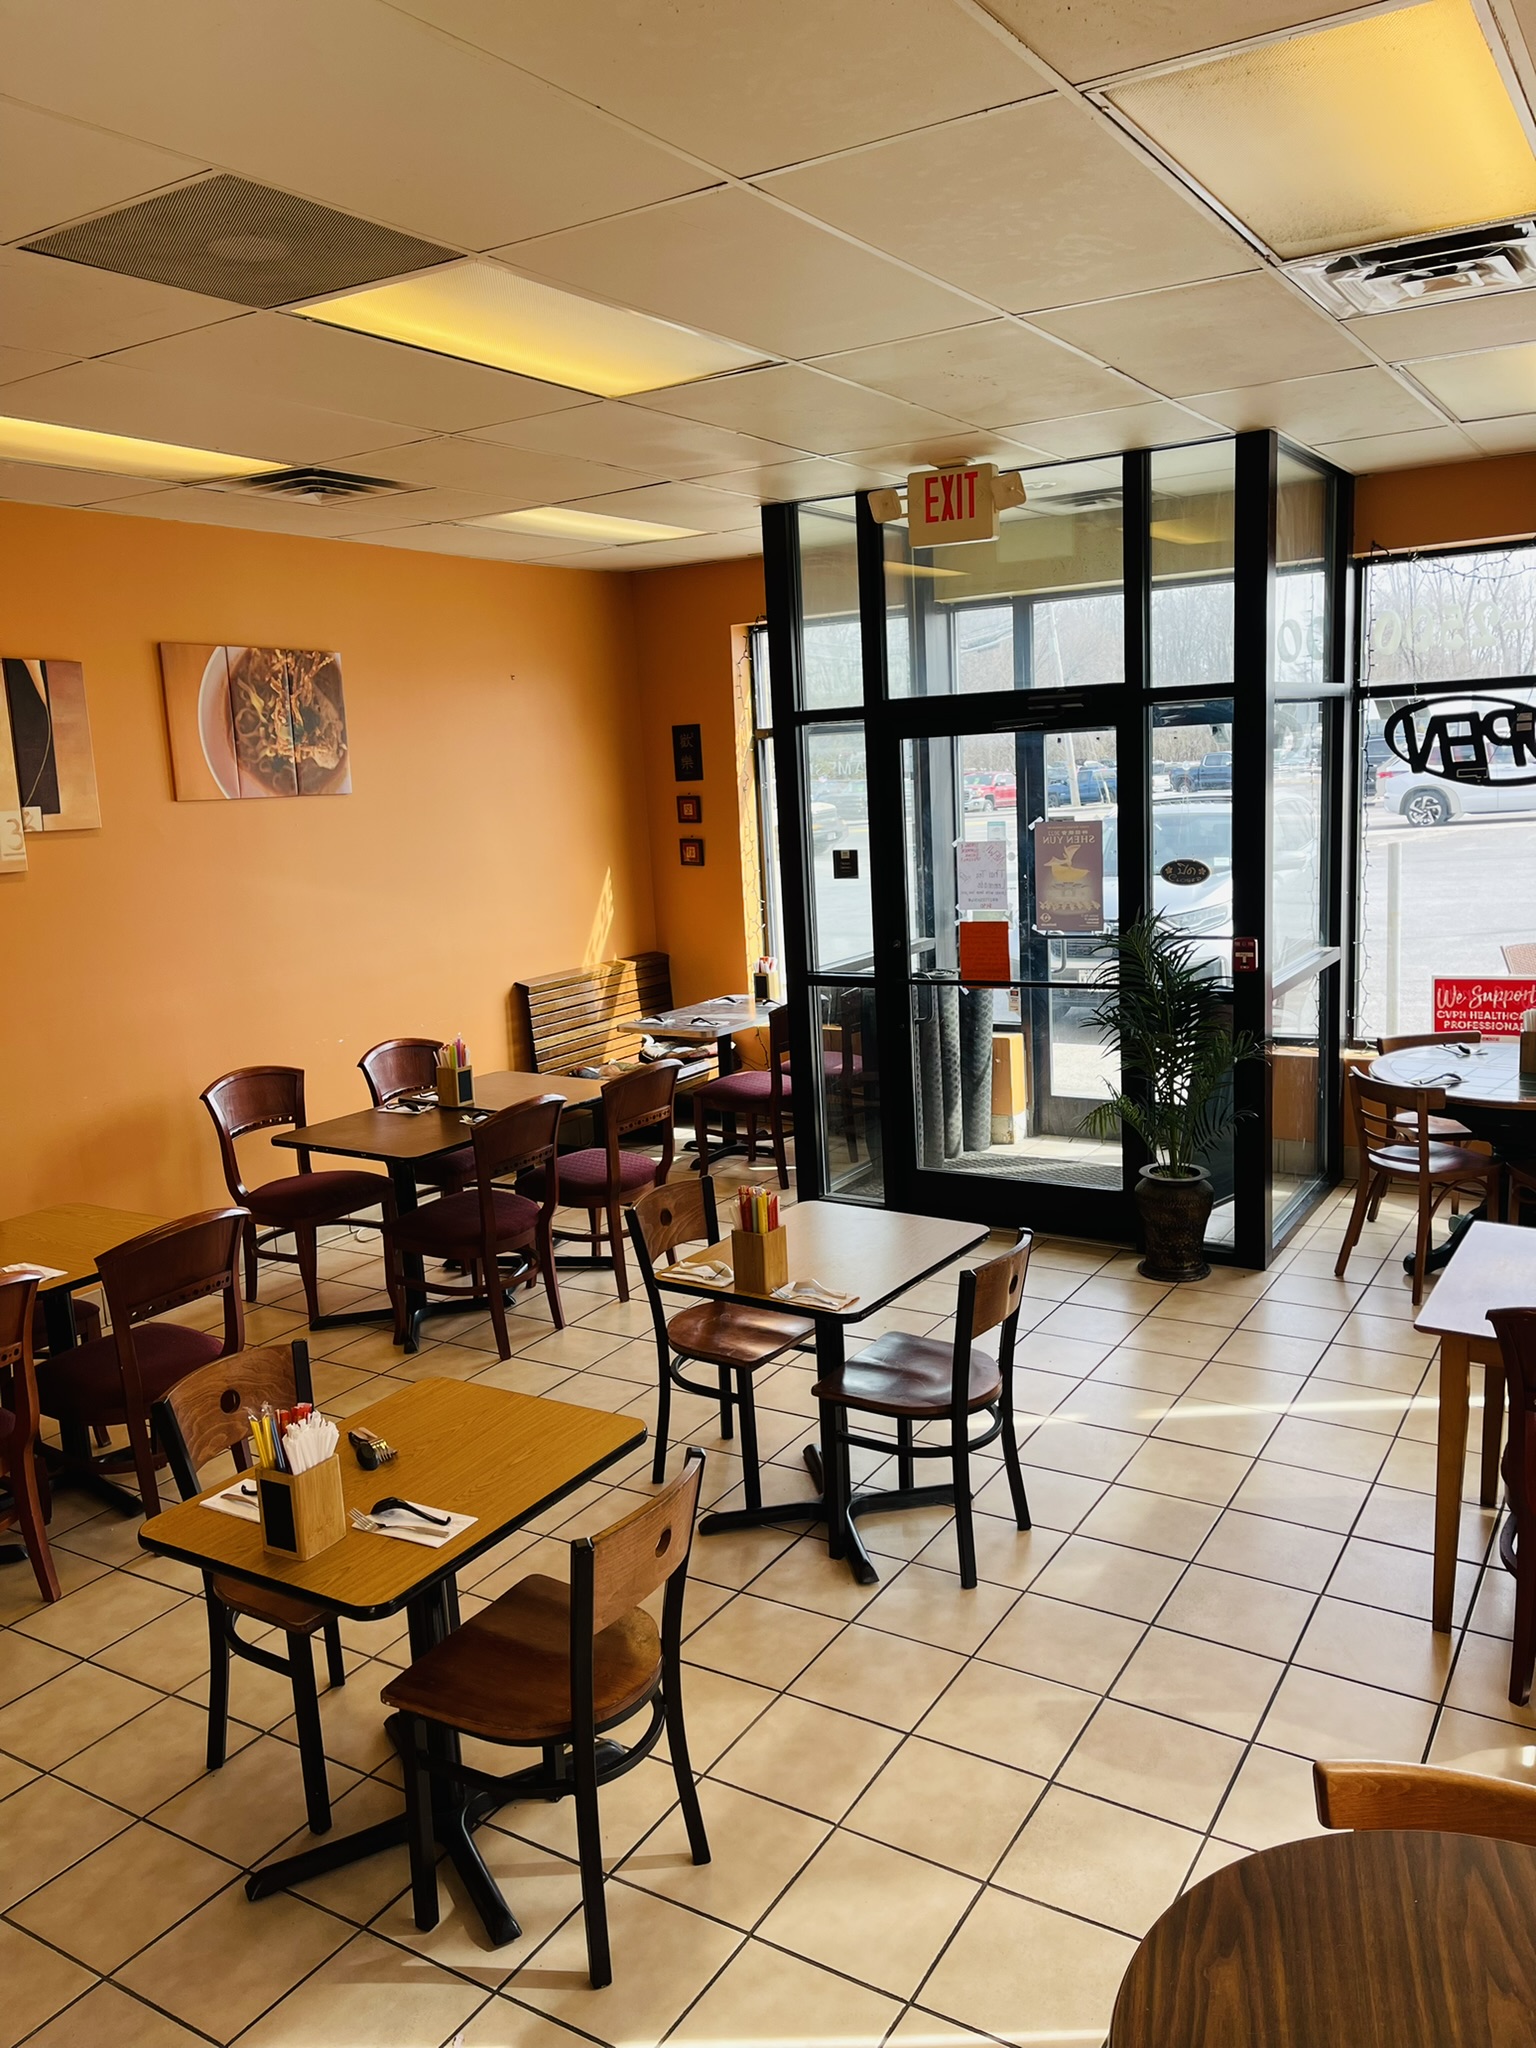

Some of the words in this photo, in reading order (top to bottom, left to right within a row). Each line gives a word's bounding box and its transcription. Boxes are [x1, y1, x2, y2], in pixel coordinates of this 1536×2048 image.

[924, 471, 979, 523] EXIT
[6, 818, 23, 850] 3
[1436, 984, 1466, 1009] We
[1468, 984, 1536, 1009] Support
[1436, 1010, 1467, 1019] CVPH
